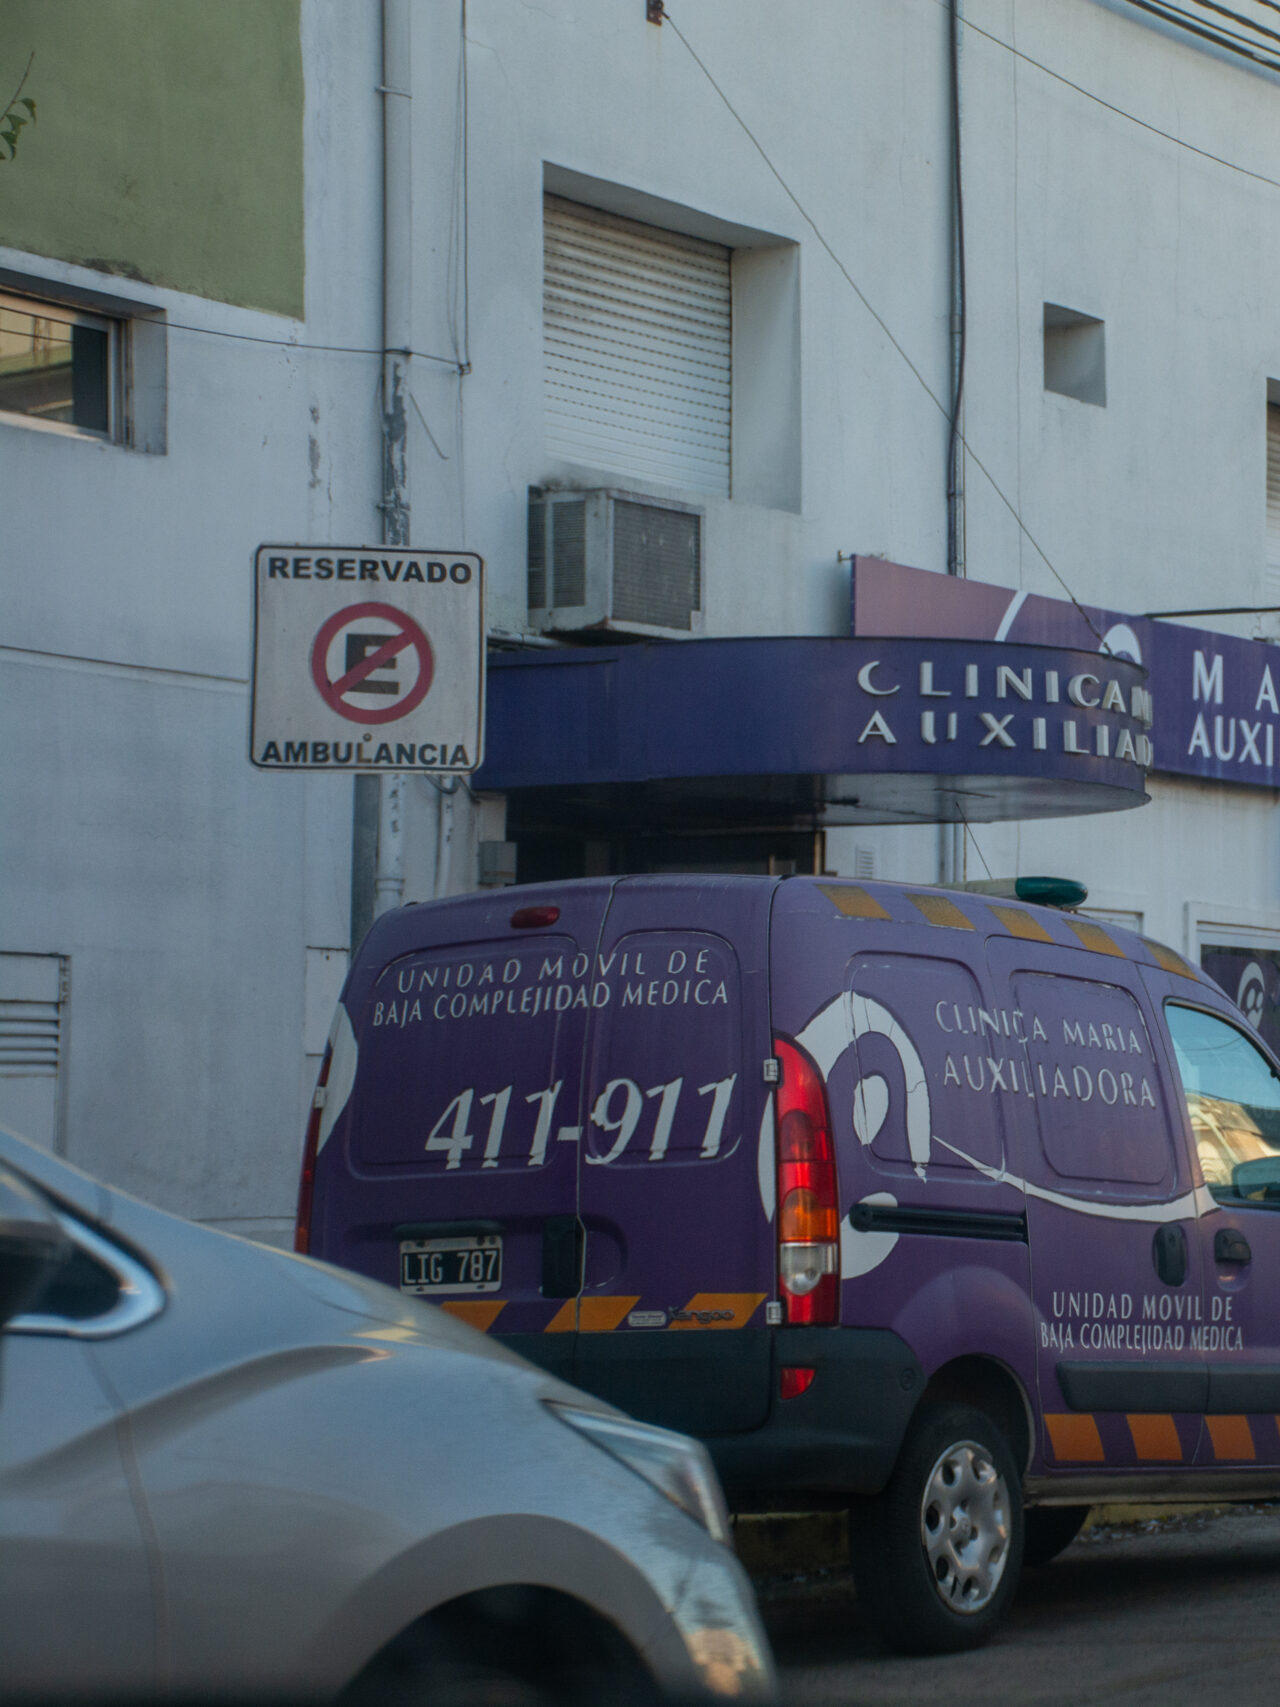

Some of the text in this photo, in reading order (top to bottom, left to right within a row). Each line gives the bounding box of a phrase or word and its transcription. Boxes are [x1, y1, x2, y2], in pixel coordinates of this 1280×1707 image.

[268, 557, 472, 584] RESERVADO
[858, 660, 1128, 714] CLINICA
[261, 741, 470, 766] AMBULANCIA
[398, 958, 521, 993] UNIDAD
[667, 949, 709, 974] DE
[372, 979, 728, 1029] BAJA COMPLEJIDAD MEDICA
[935, 1000, 1143, 1056] CLINICA MARIA
[943, 1053, 1157, 1109] AUXILIADORA
[425, 1072, 738, 1171] 411-911
[403, 1249, 499, 1286] LIG 787
[668, 1306, 735, 1324] Kangoo
[1053, 1291, 1233, 1322] UNIDAD MOVIL DE
[1041, 1322, 1244, 1355] BAJA COMPLEJIDAD MEDICA
